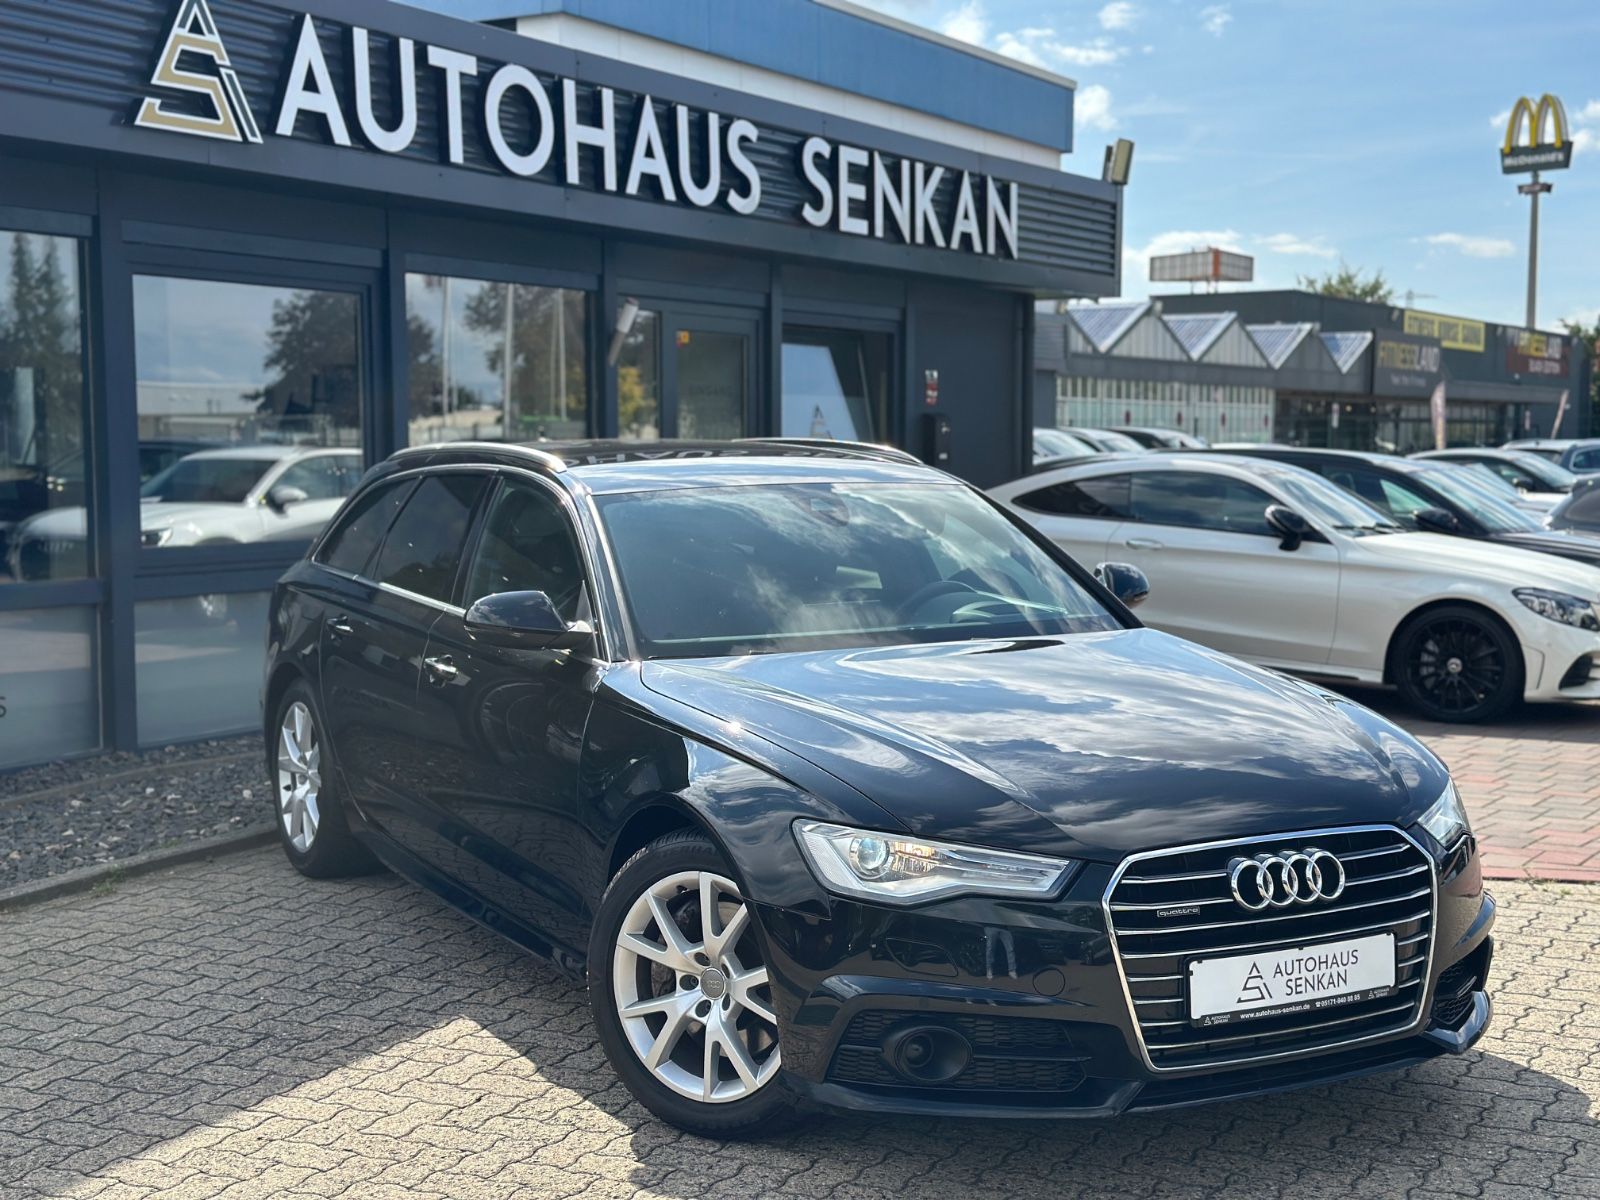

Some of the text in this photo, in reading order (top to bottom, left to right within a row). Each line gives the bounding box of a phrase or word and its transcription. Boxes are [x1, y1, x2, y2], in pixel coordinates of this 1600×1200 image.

[276, 13, 1018, 260] AUTOHAUS SENKAN
[1159, 907, 1199, 917] quattro
[1273, 949, 1359, 979] AUTOHAUS
[1285, 968, 1348, 997] SENKAN
[1239, 1003, 1311, 1019] www.autohaus-senkan.de
